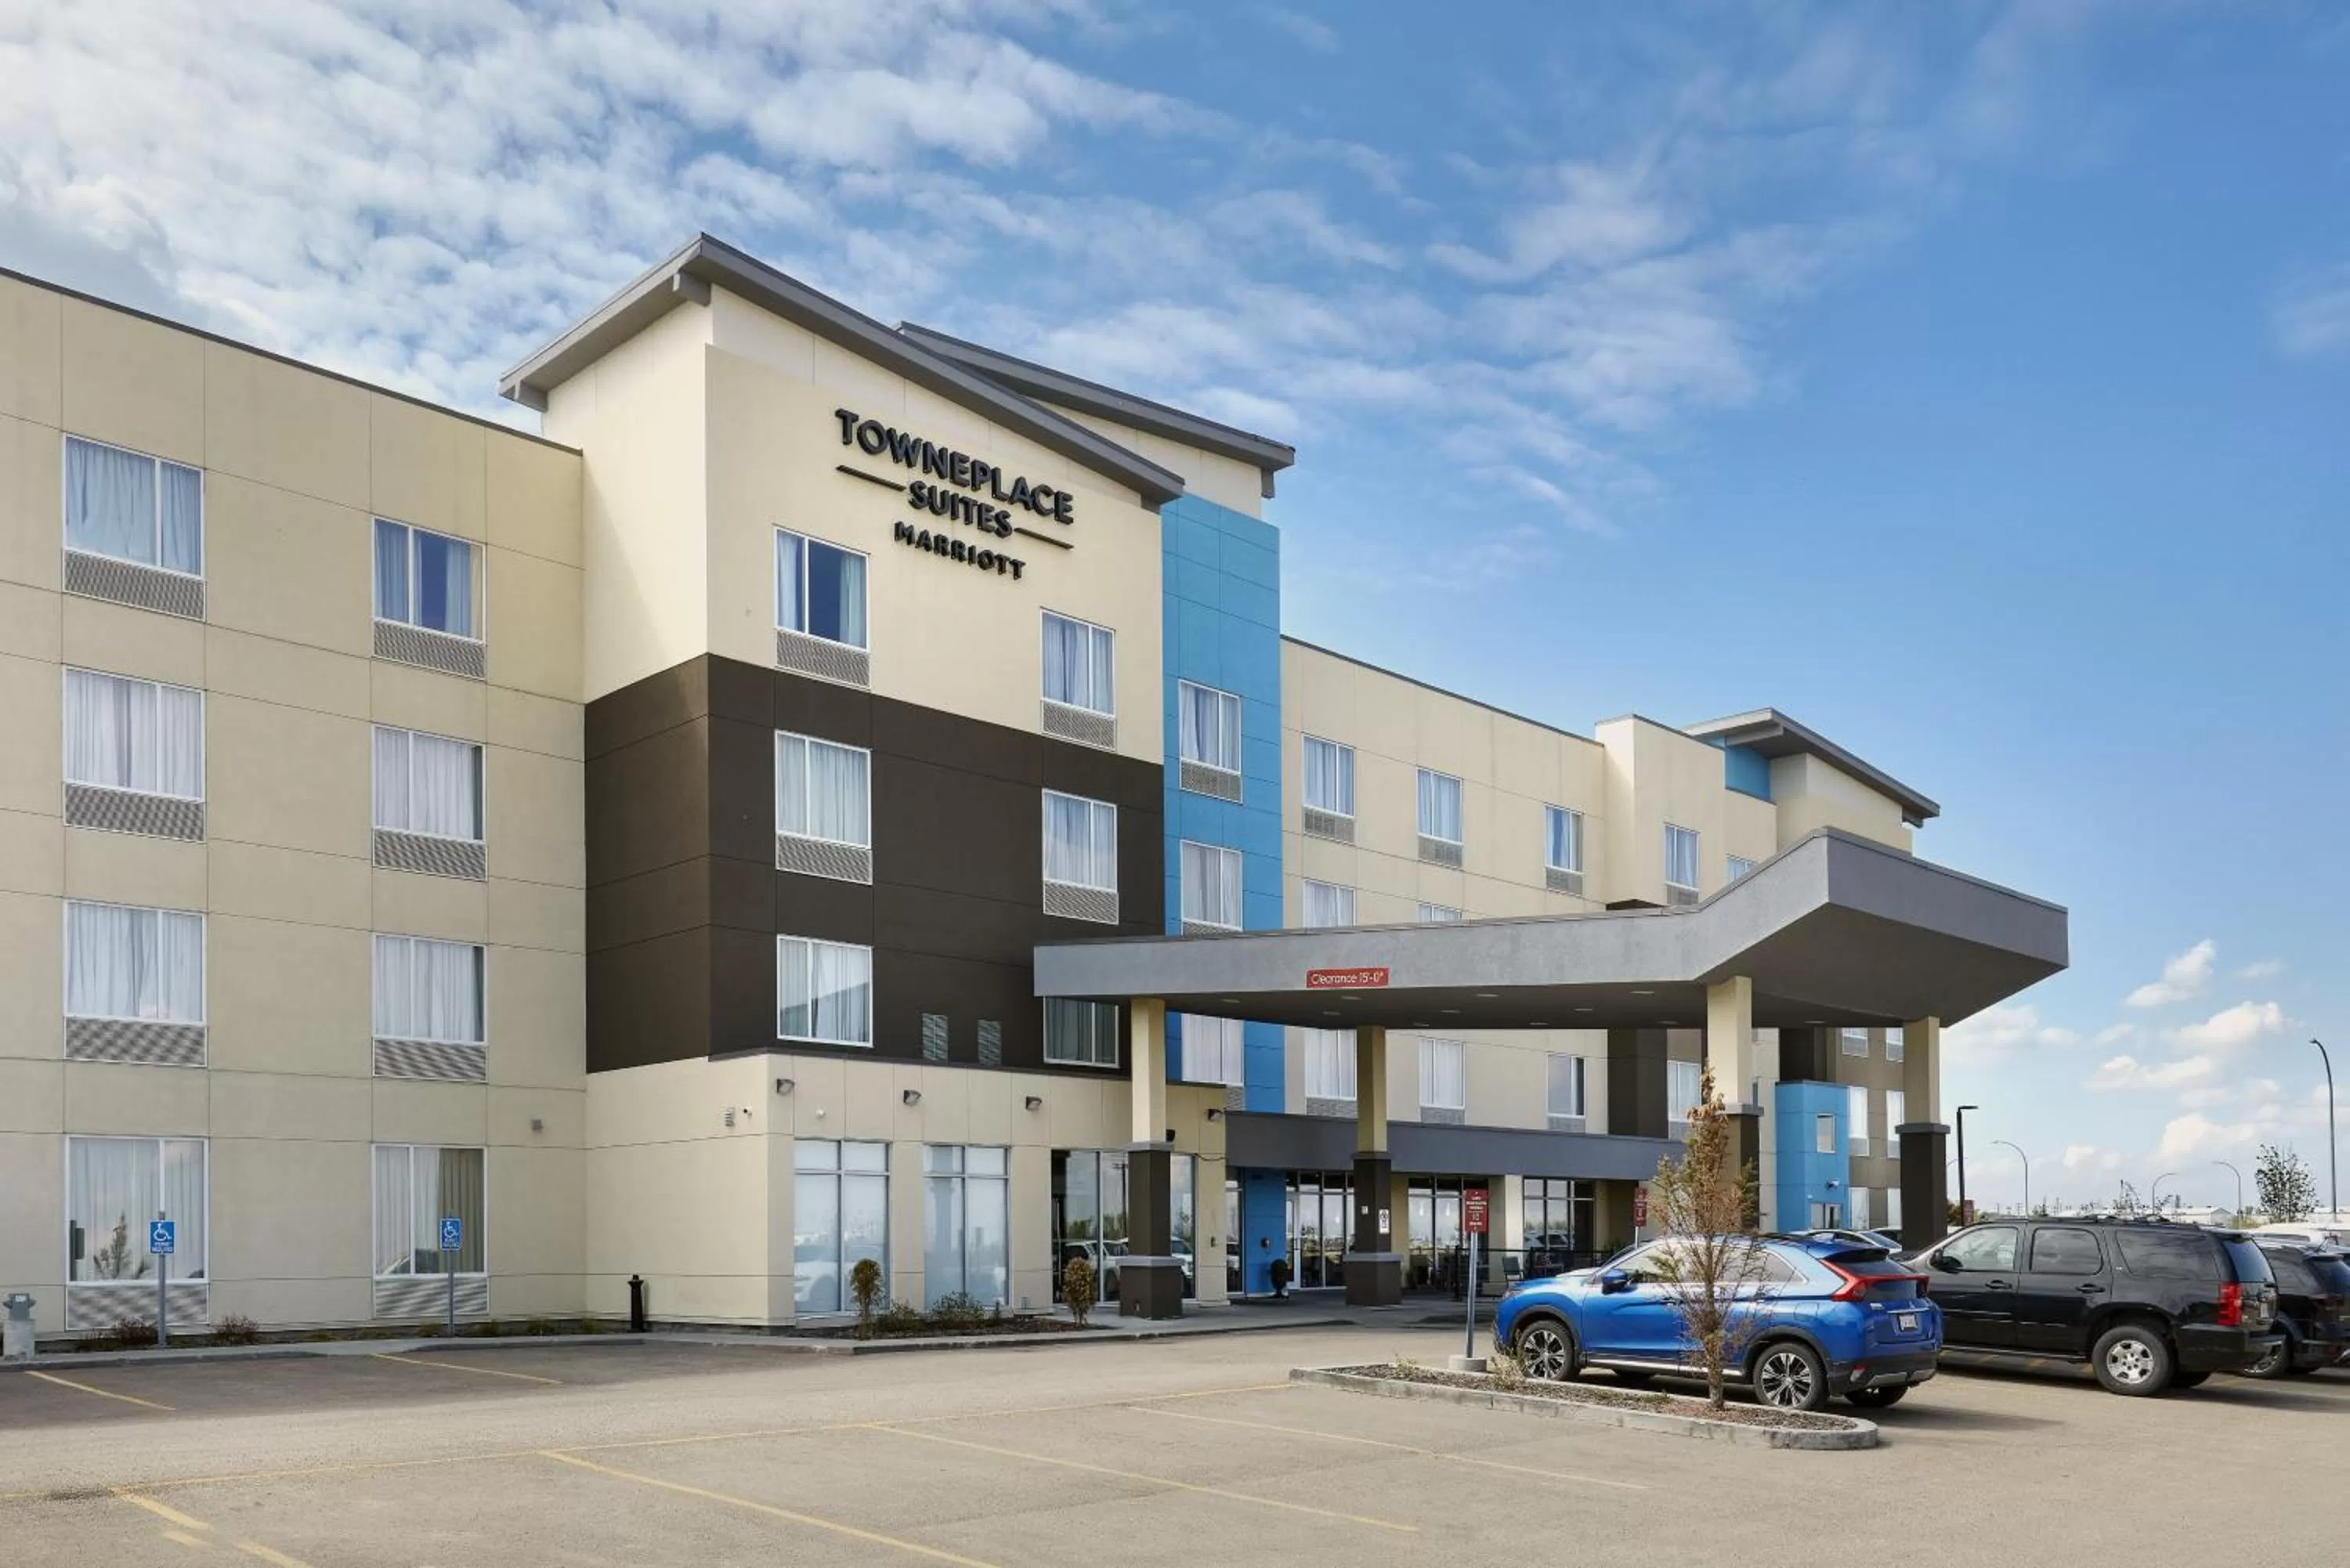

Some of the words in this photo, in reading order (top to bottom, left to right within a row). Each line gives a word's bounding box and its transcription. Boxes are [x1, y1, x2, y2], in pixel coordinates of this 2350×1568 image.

[834, 407, 1074, 525] TOWNEPLACE
[909, 480, 1013, 539] SUITES
[893, 521, 1026, 580] MARRIOTT
[1311, 973, 1358, 985] Clearance
